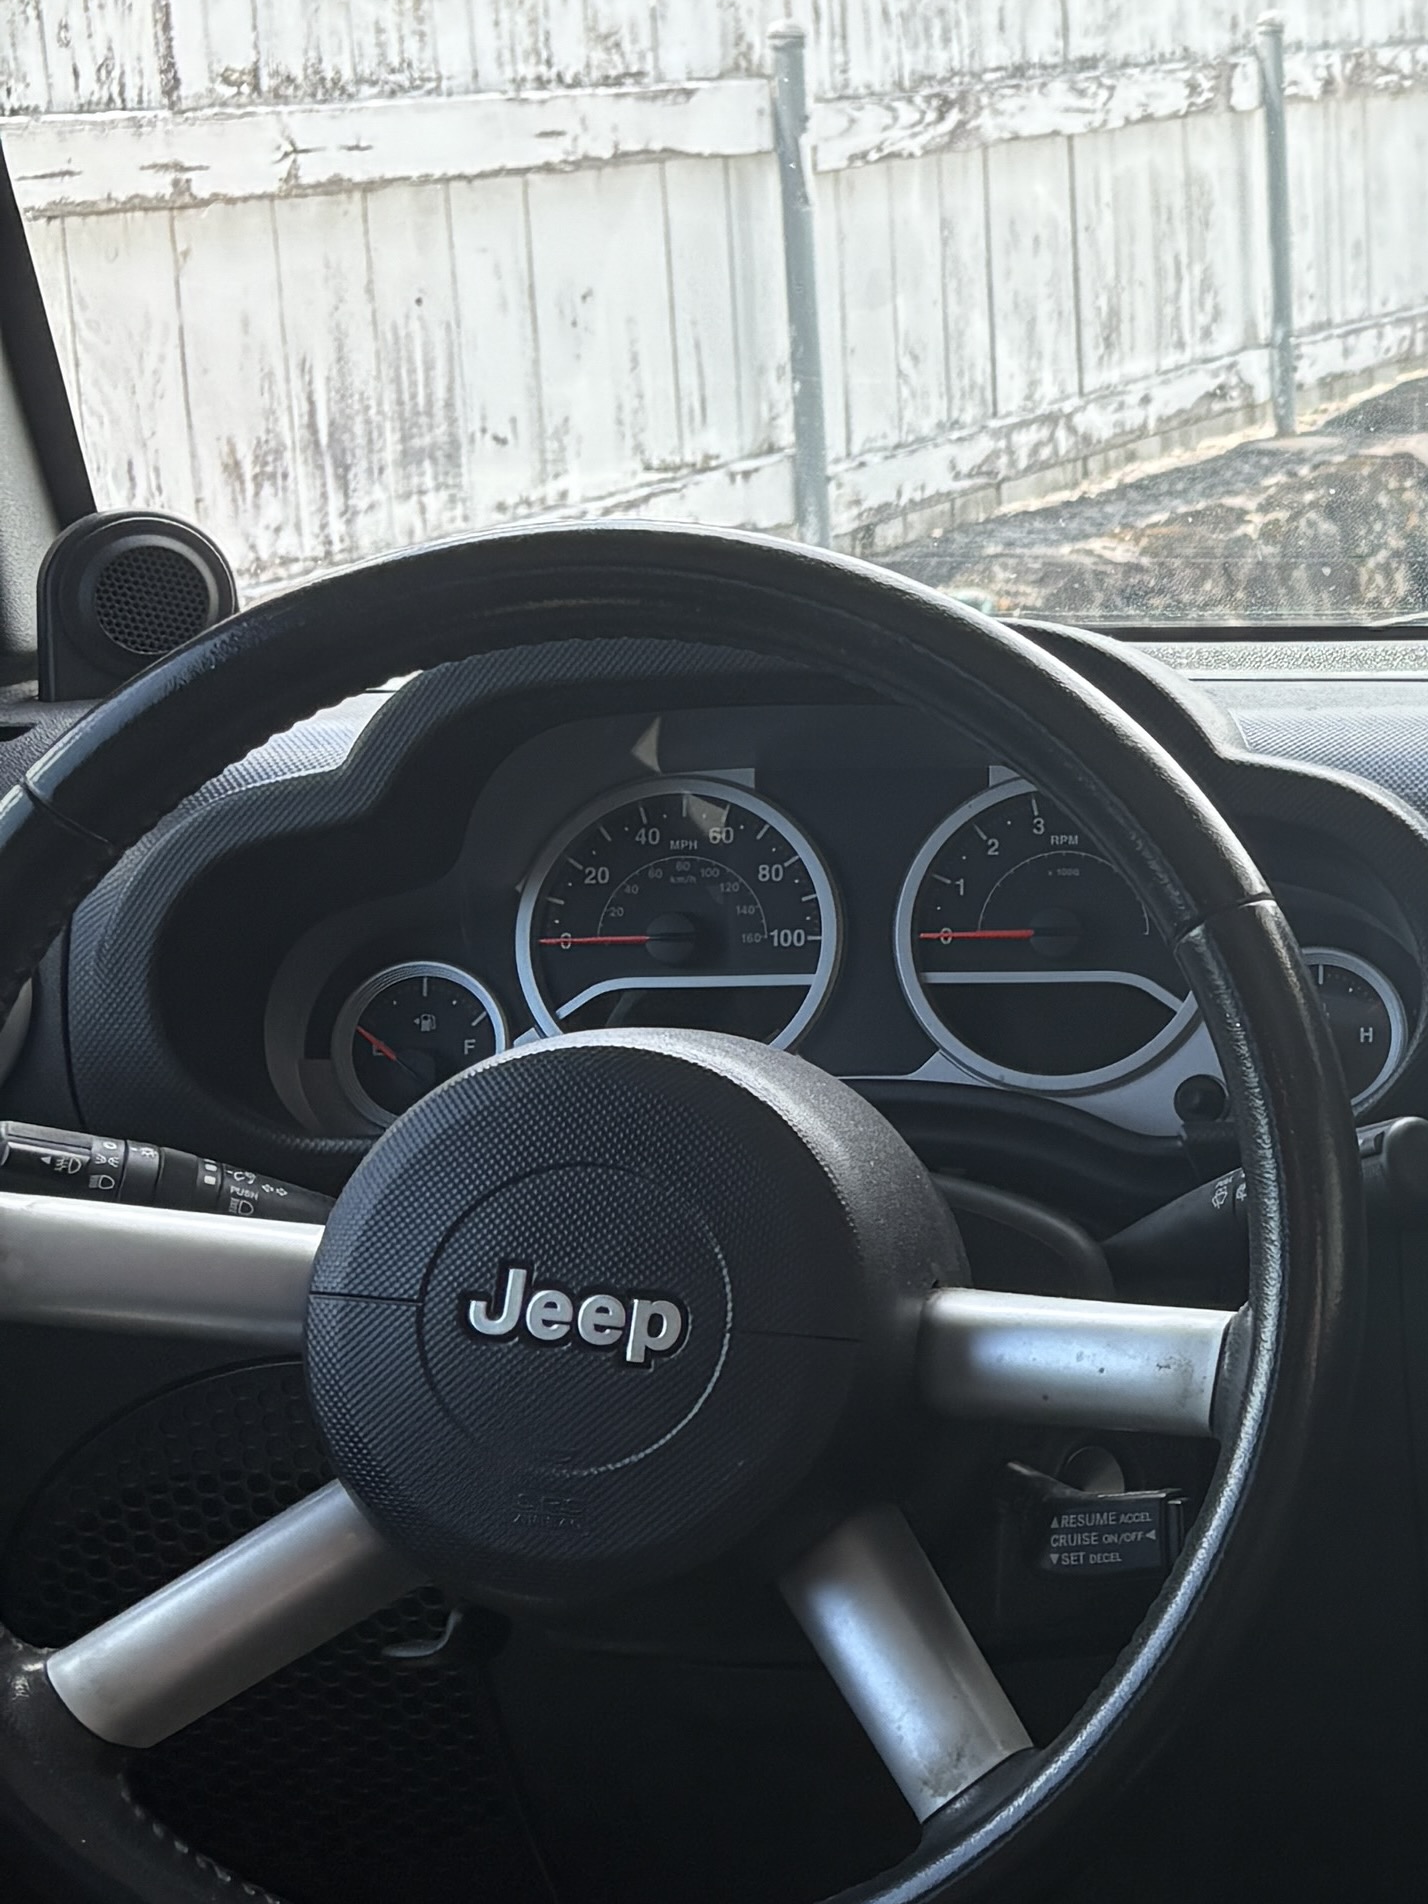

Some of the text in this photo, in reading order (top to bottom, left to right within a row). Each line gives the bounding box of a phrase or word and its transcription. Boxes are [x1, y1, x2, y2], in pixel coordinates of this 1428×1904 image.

[1032, 817, 1045, 835] 3
[635, 828, 660, 846] 40
[708, 826, 734, 844] 60
[1050, 835, 1079, 845] RPM
[670, 840, 698, 850] MPH
[987, 838, 999, 855] 2
[584, 867, 610, 885] 20
[758, 864, 783, 882] 80
[624, 883, 639, 894] 40
[955, 878, 964, 896] 1
[560, 932, 572, 950] 0
[769, 929, 806, 947] 100
[940, 927, 952, 945] 0
[1360, 1027, 1373, 1043] H
[464, 1039, 476, 1055] F
[230, 1185, 259, 1201] PUSH
[467, 1266, 684, 1364] Jeep
[1061, 1511, 1152, 1528] RESUME ACCEL
[1050, 1531, 1144, 1547] CRUISE ON/OFF
[1061, 1551, 1122, 1566] SET DECEL
